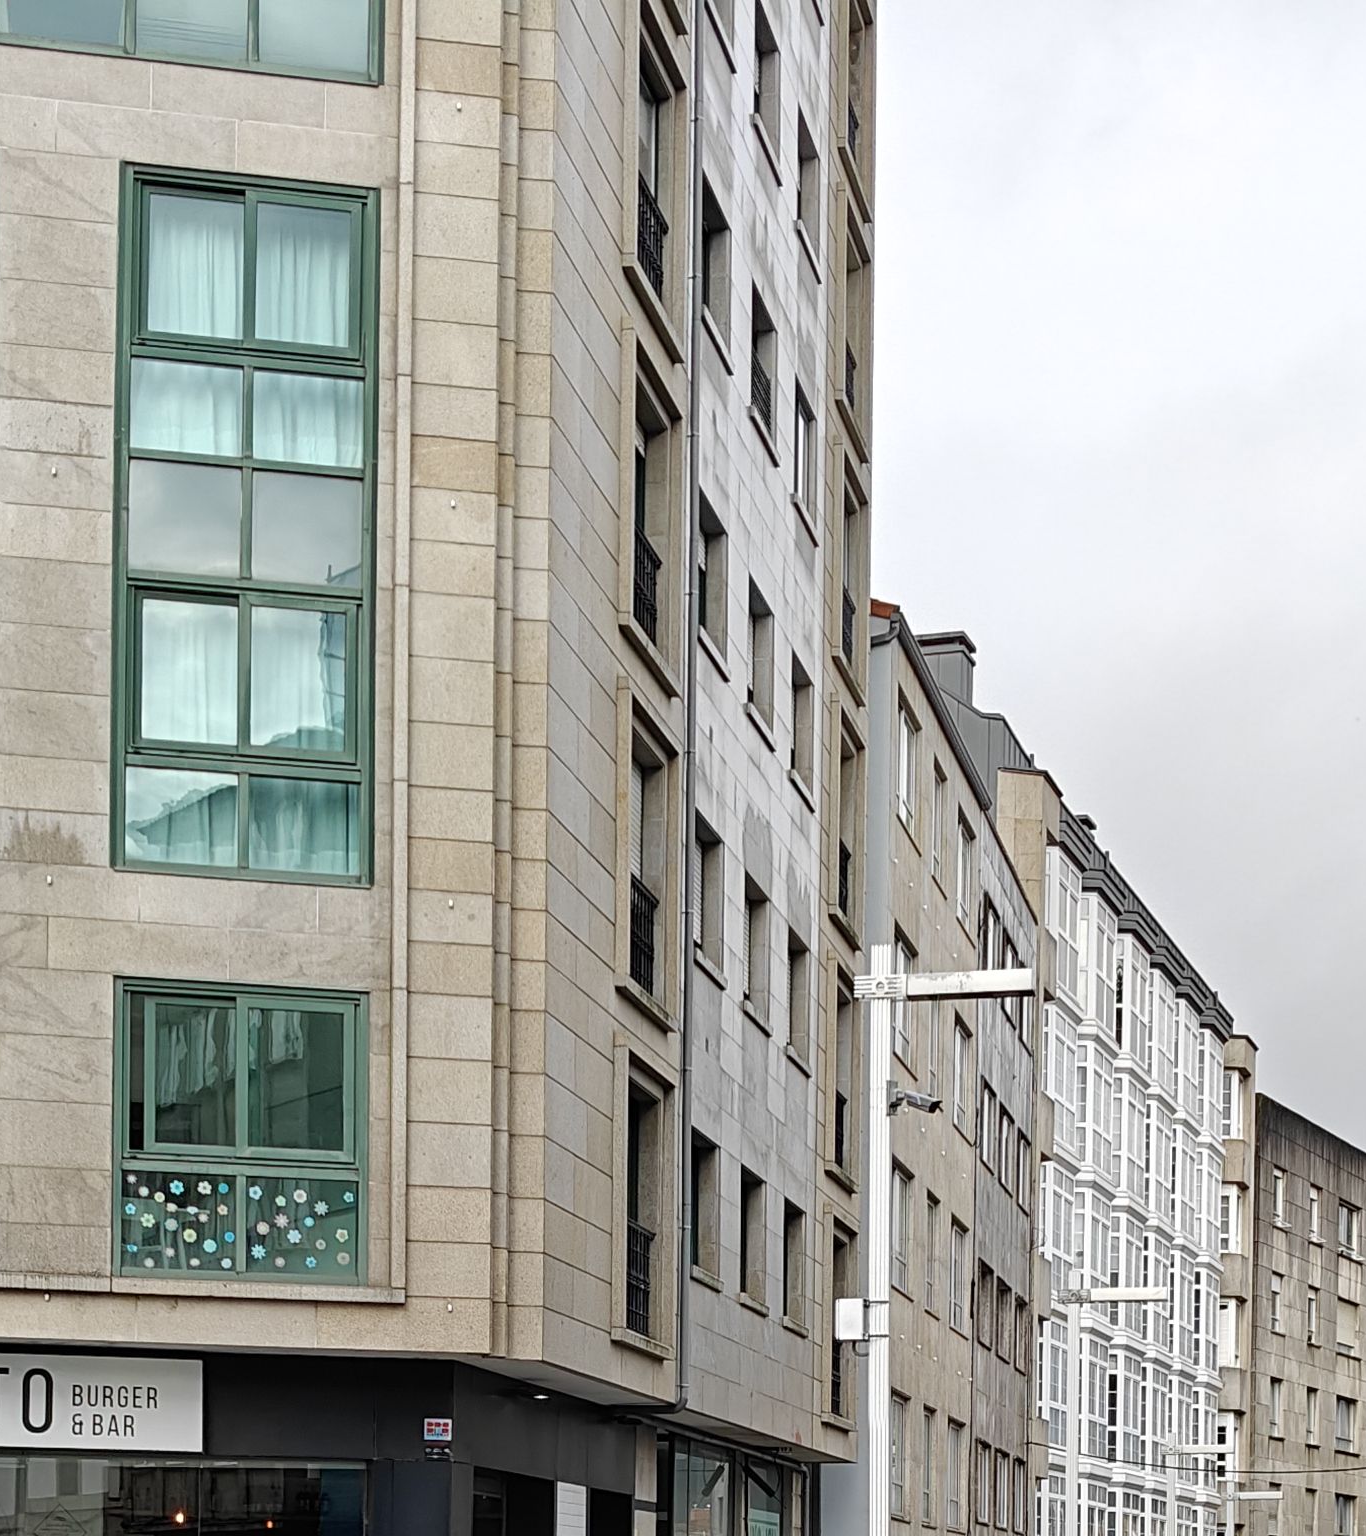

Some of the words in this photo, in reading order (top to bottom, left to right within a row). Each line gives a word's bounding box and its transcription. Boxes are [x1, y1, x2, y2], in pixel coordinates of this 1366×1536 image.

[71, 1384, 159, 1409] BURGER
[71, 1413, 84, 1436] &
[91, 1414, 136, 1438] BAR
